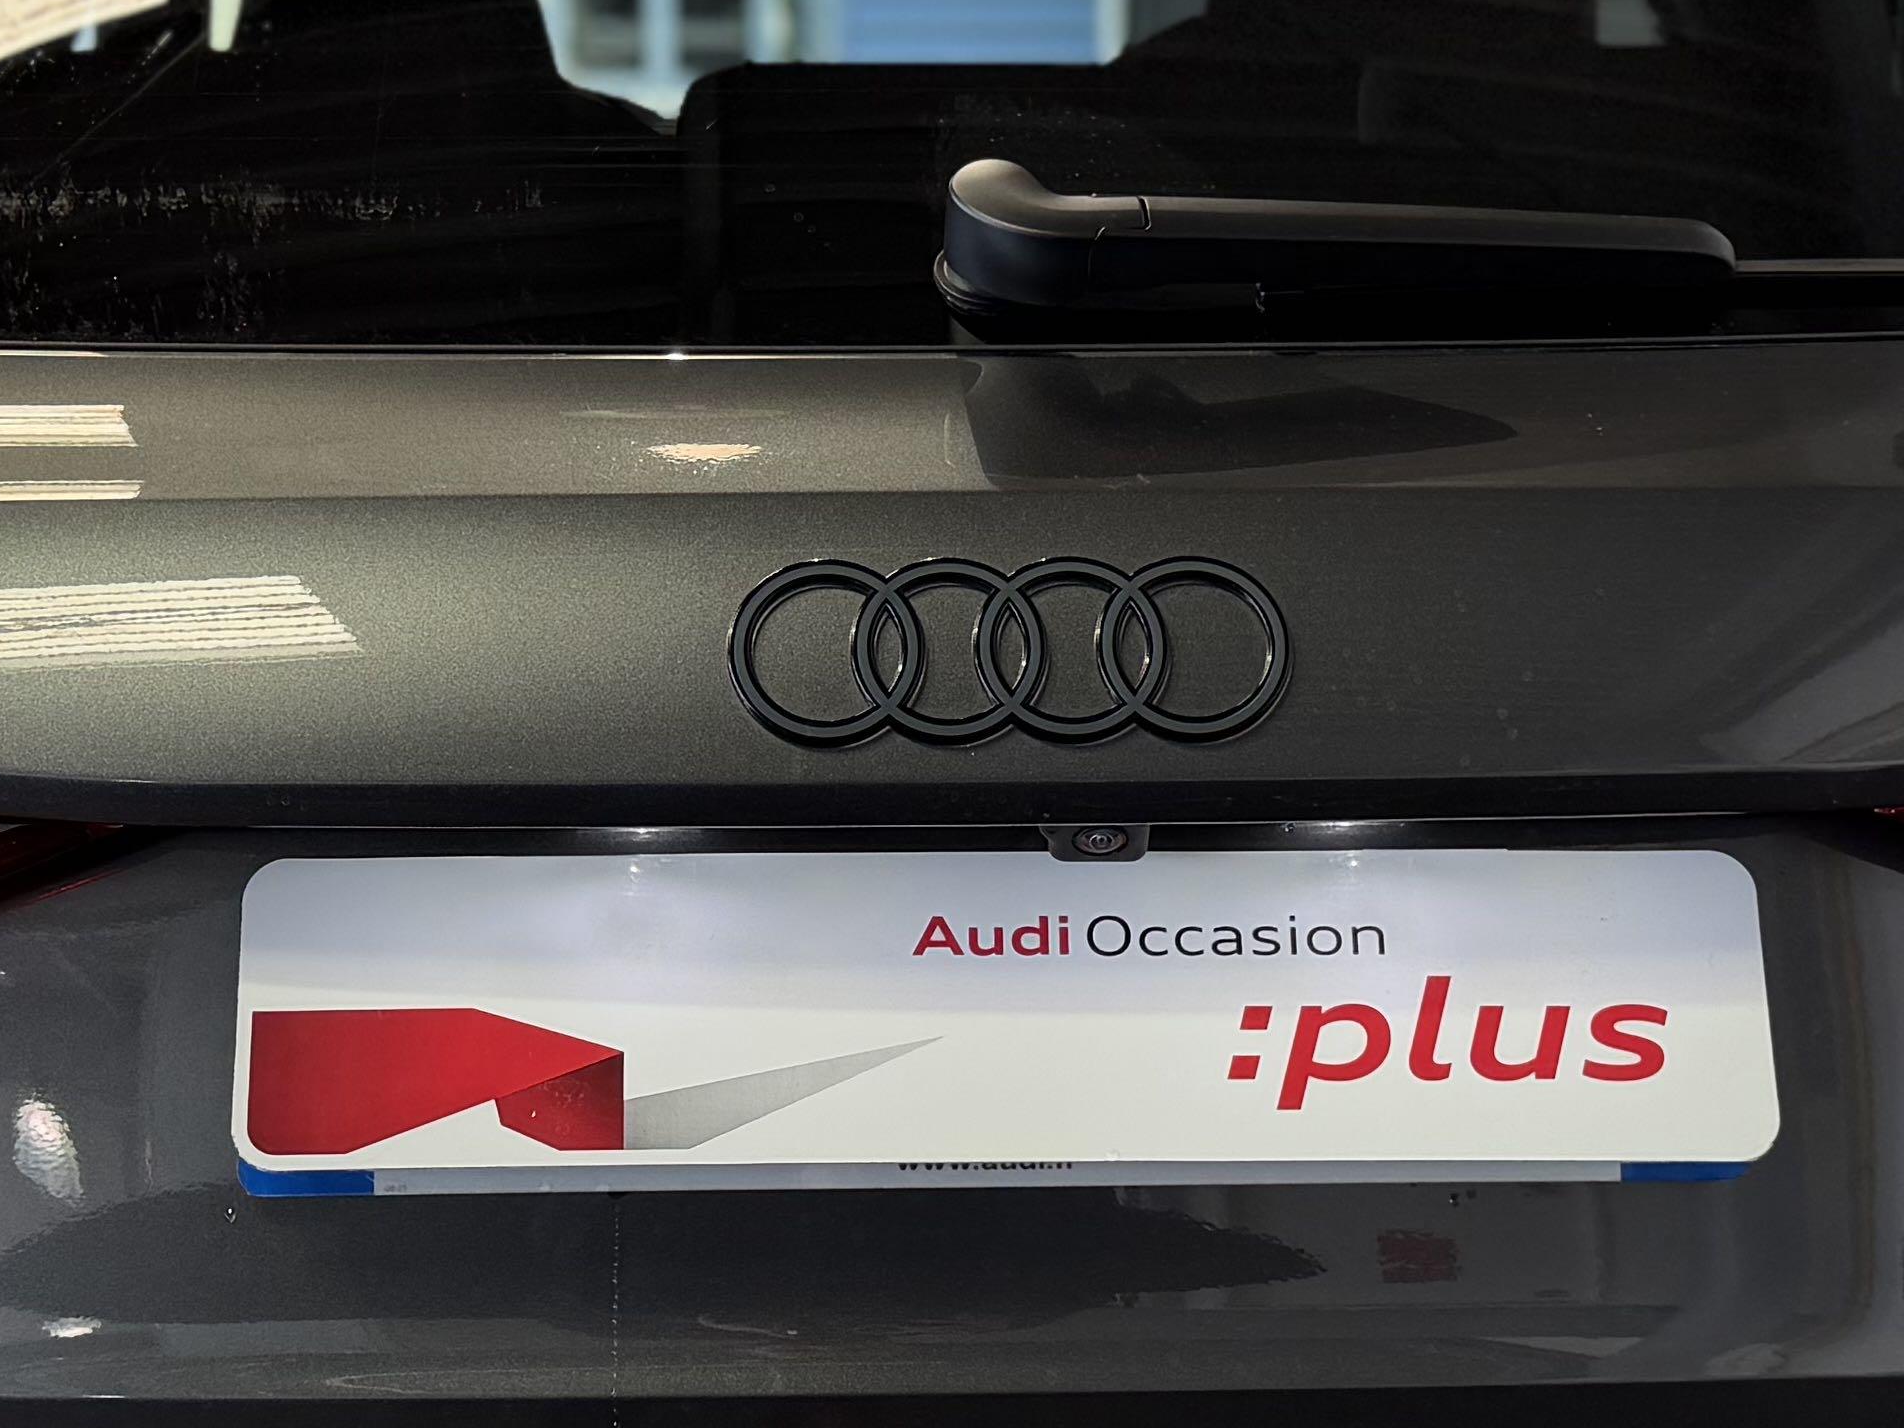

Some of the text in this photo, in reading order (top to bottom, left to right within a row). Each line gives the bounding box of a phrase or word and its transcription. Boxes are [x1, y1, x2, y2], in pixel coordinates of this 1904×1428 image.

[911, 914, 1389, 958] Audi Occasion
[1226, 974, 1671, 1112] :plus
